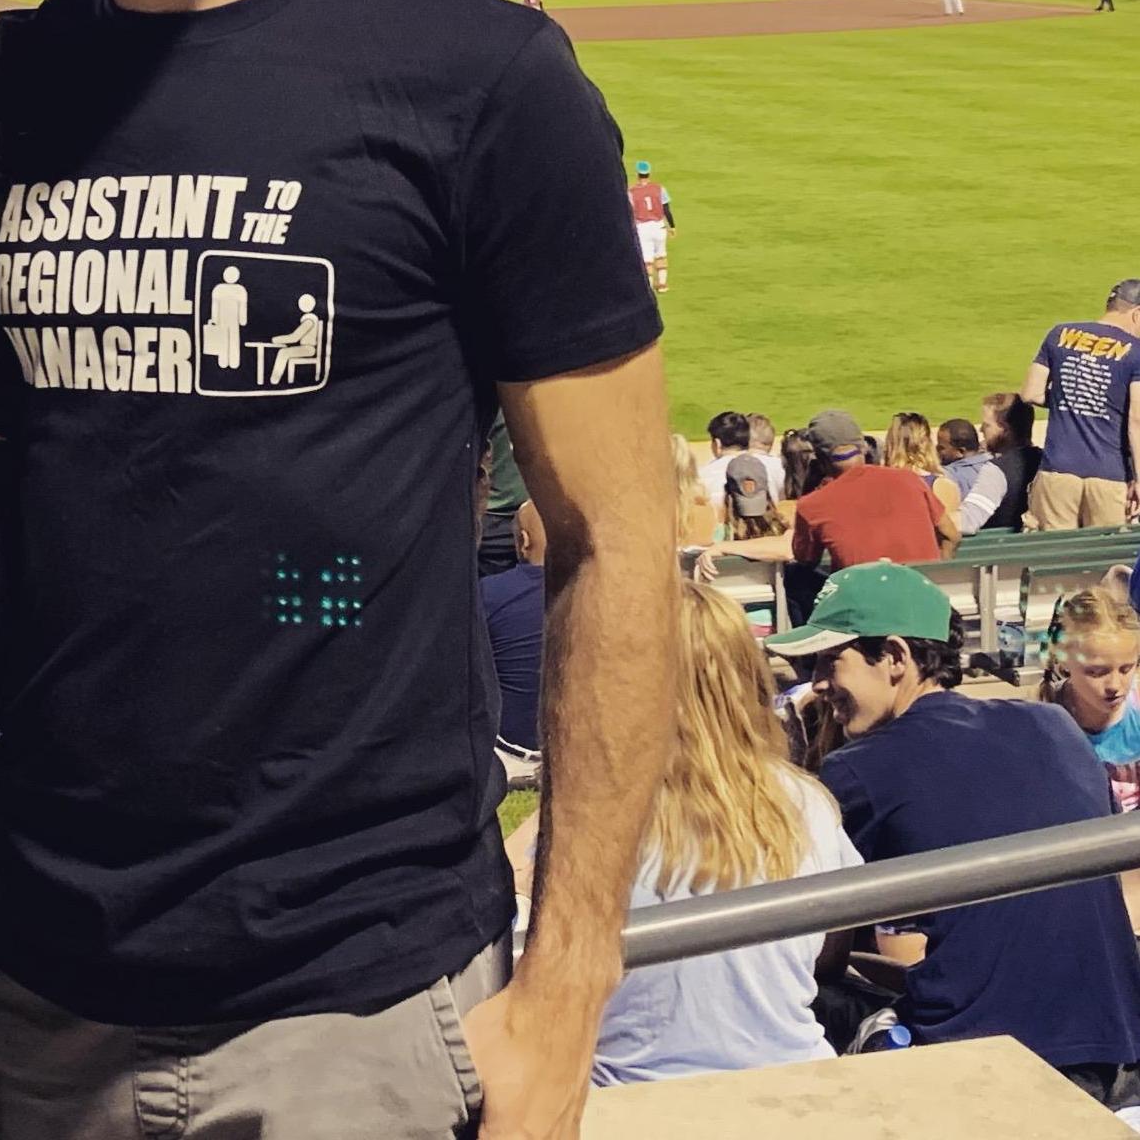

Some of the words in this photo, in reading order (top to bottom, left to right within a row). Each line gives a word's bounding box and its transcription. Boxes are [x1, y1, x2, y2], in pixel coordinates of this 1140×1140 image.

[264, 179, 303, 211] TO
[239, 212, 292, 244] THE
[1058, 327, 1132, 362] WEEN
